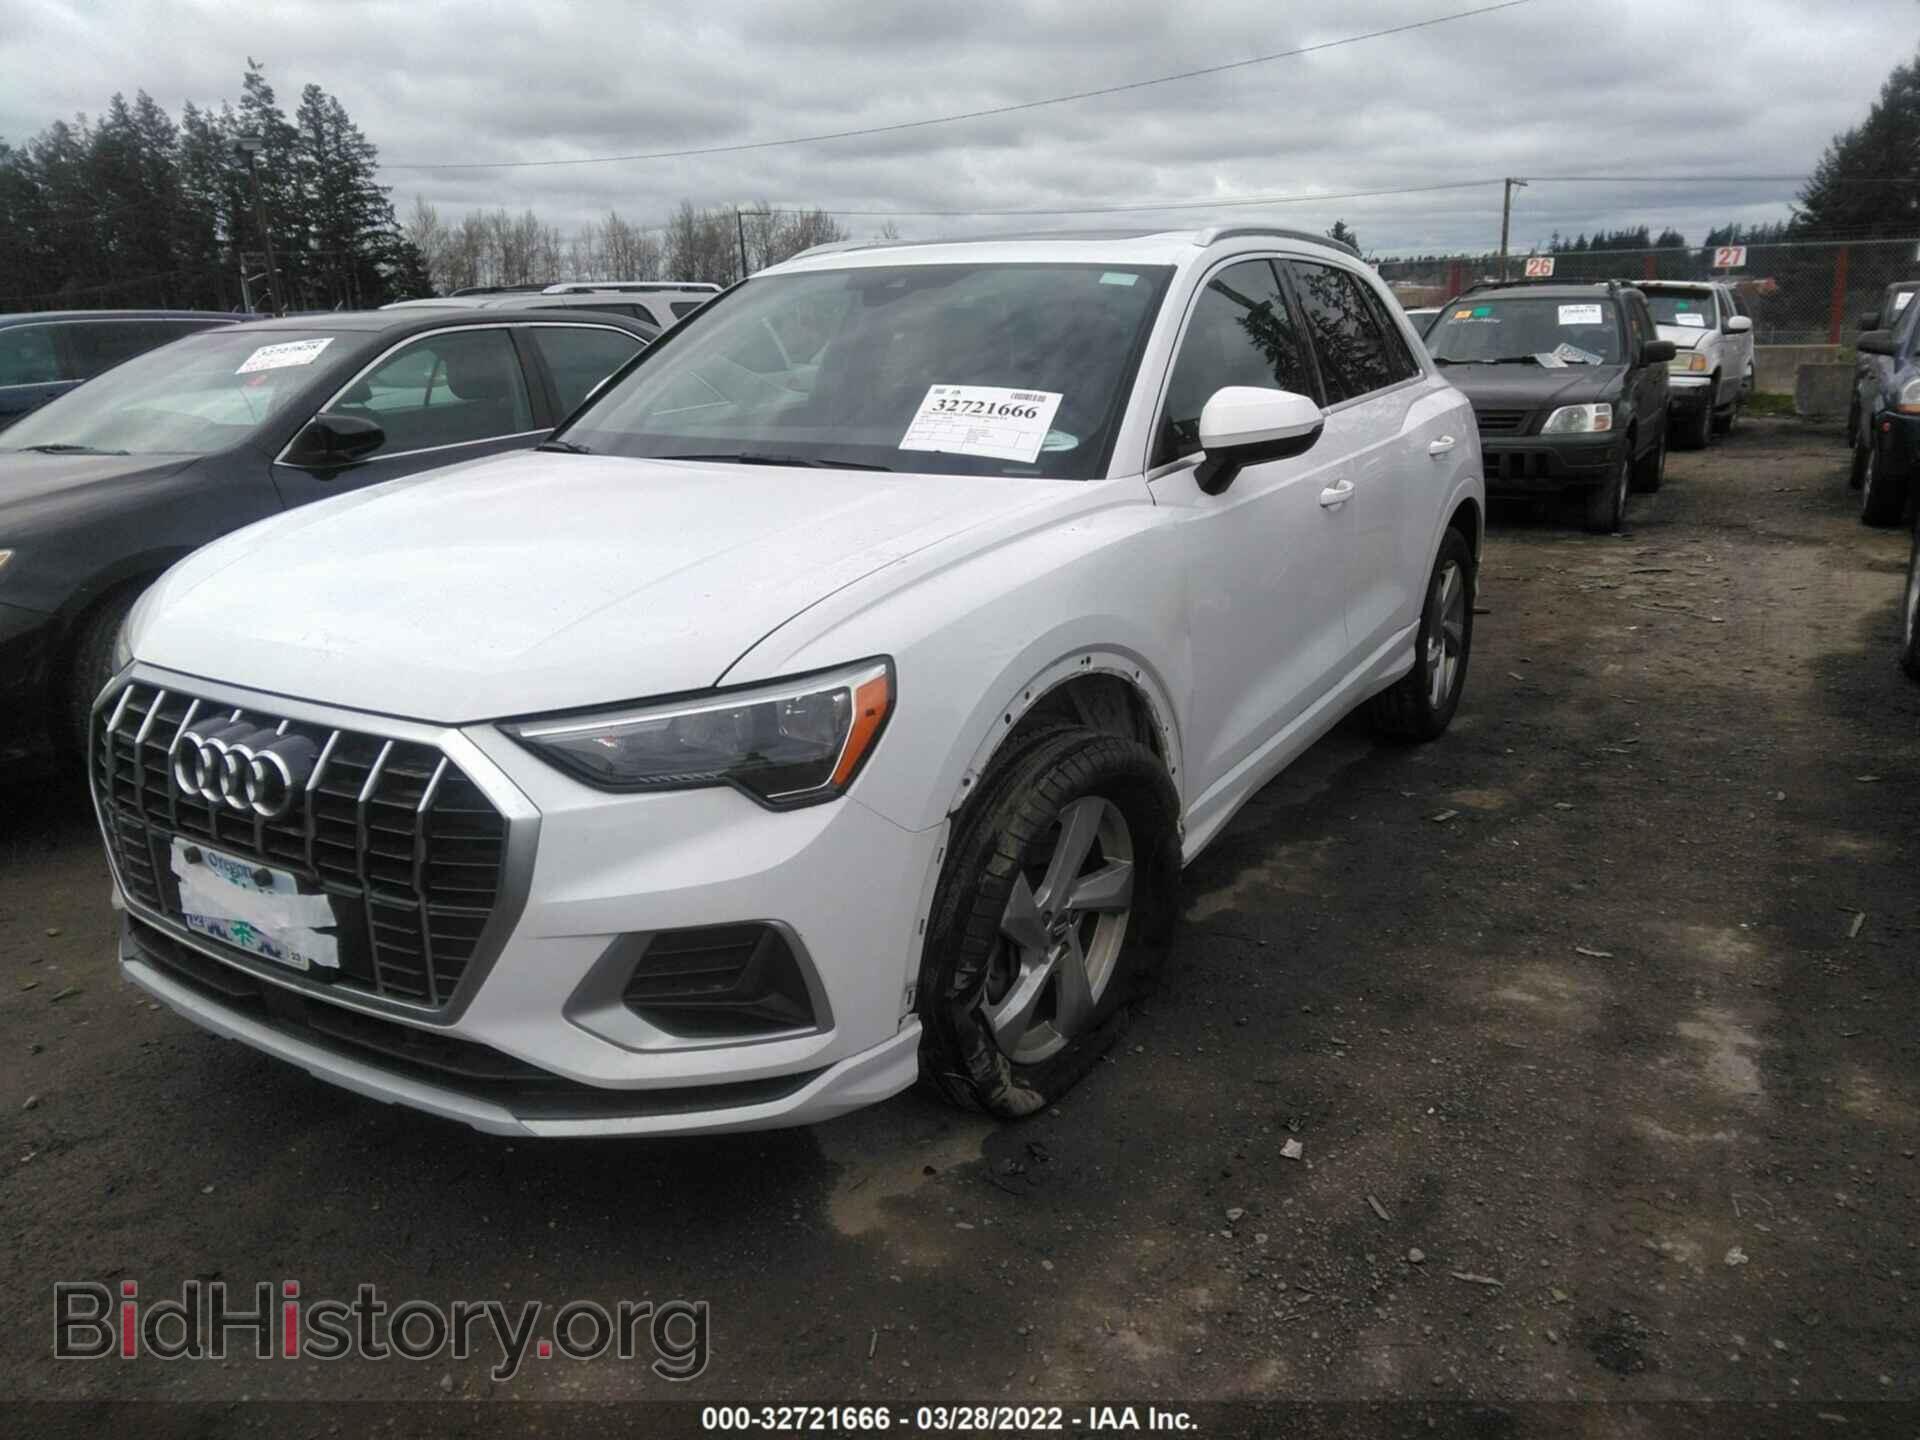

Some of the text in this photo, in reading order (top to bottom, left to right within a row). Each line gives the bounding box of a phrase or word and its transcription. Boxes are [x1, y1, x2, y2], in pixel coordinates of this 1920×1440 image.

[1719, 247, 1743, 265] 27
[1527, 259, 1551, 275] 26
[932, 399, 1040, 419] 32721666
[207, 852, 253, 879] Oregon
